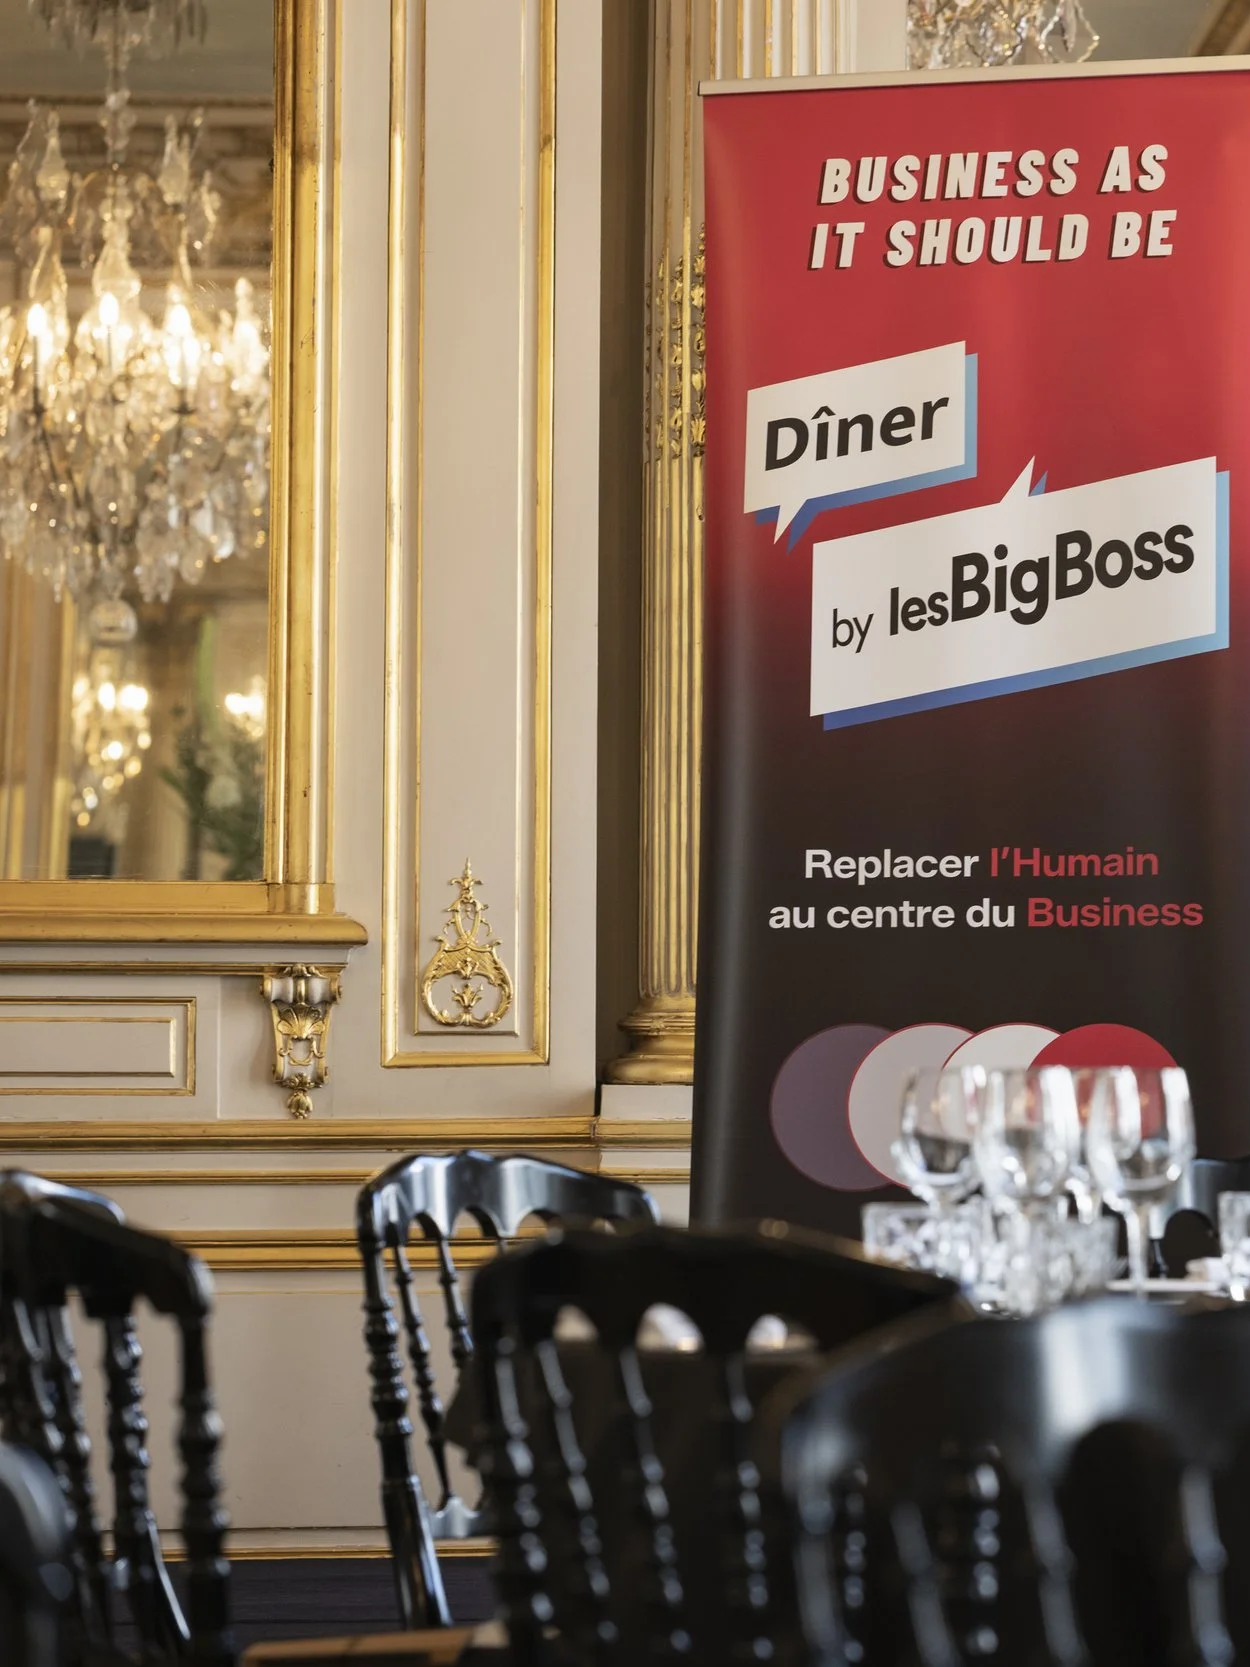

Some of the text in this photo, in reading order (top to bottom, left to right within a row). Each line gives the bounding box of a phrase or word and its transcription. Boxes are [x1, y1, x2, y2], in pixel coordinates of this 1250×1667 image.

[819, 143, 1169, 204] BUSINESS AS
[811, 210, 1178, 269] IT SHOULD BE
[765, 397, 950, 472] Dîner
[832, 524, 1195, 654] by lesBigBoss
[805, 846, 1159, 886] Replacer l'Humain
[768, 896, 1204, 929] au centre du Business
